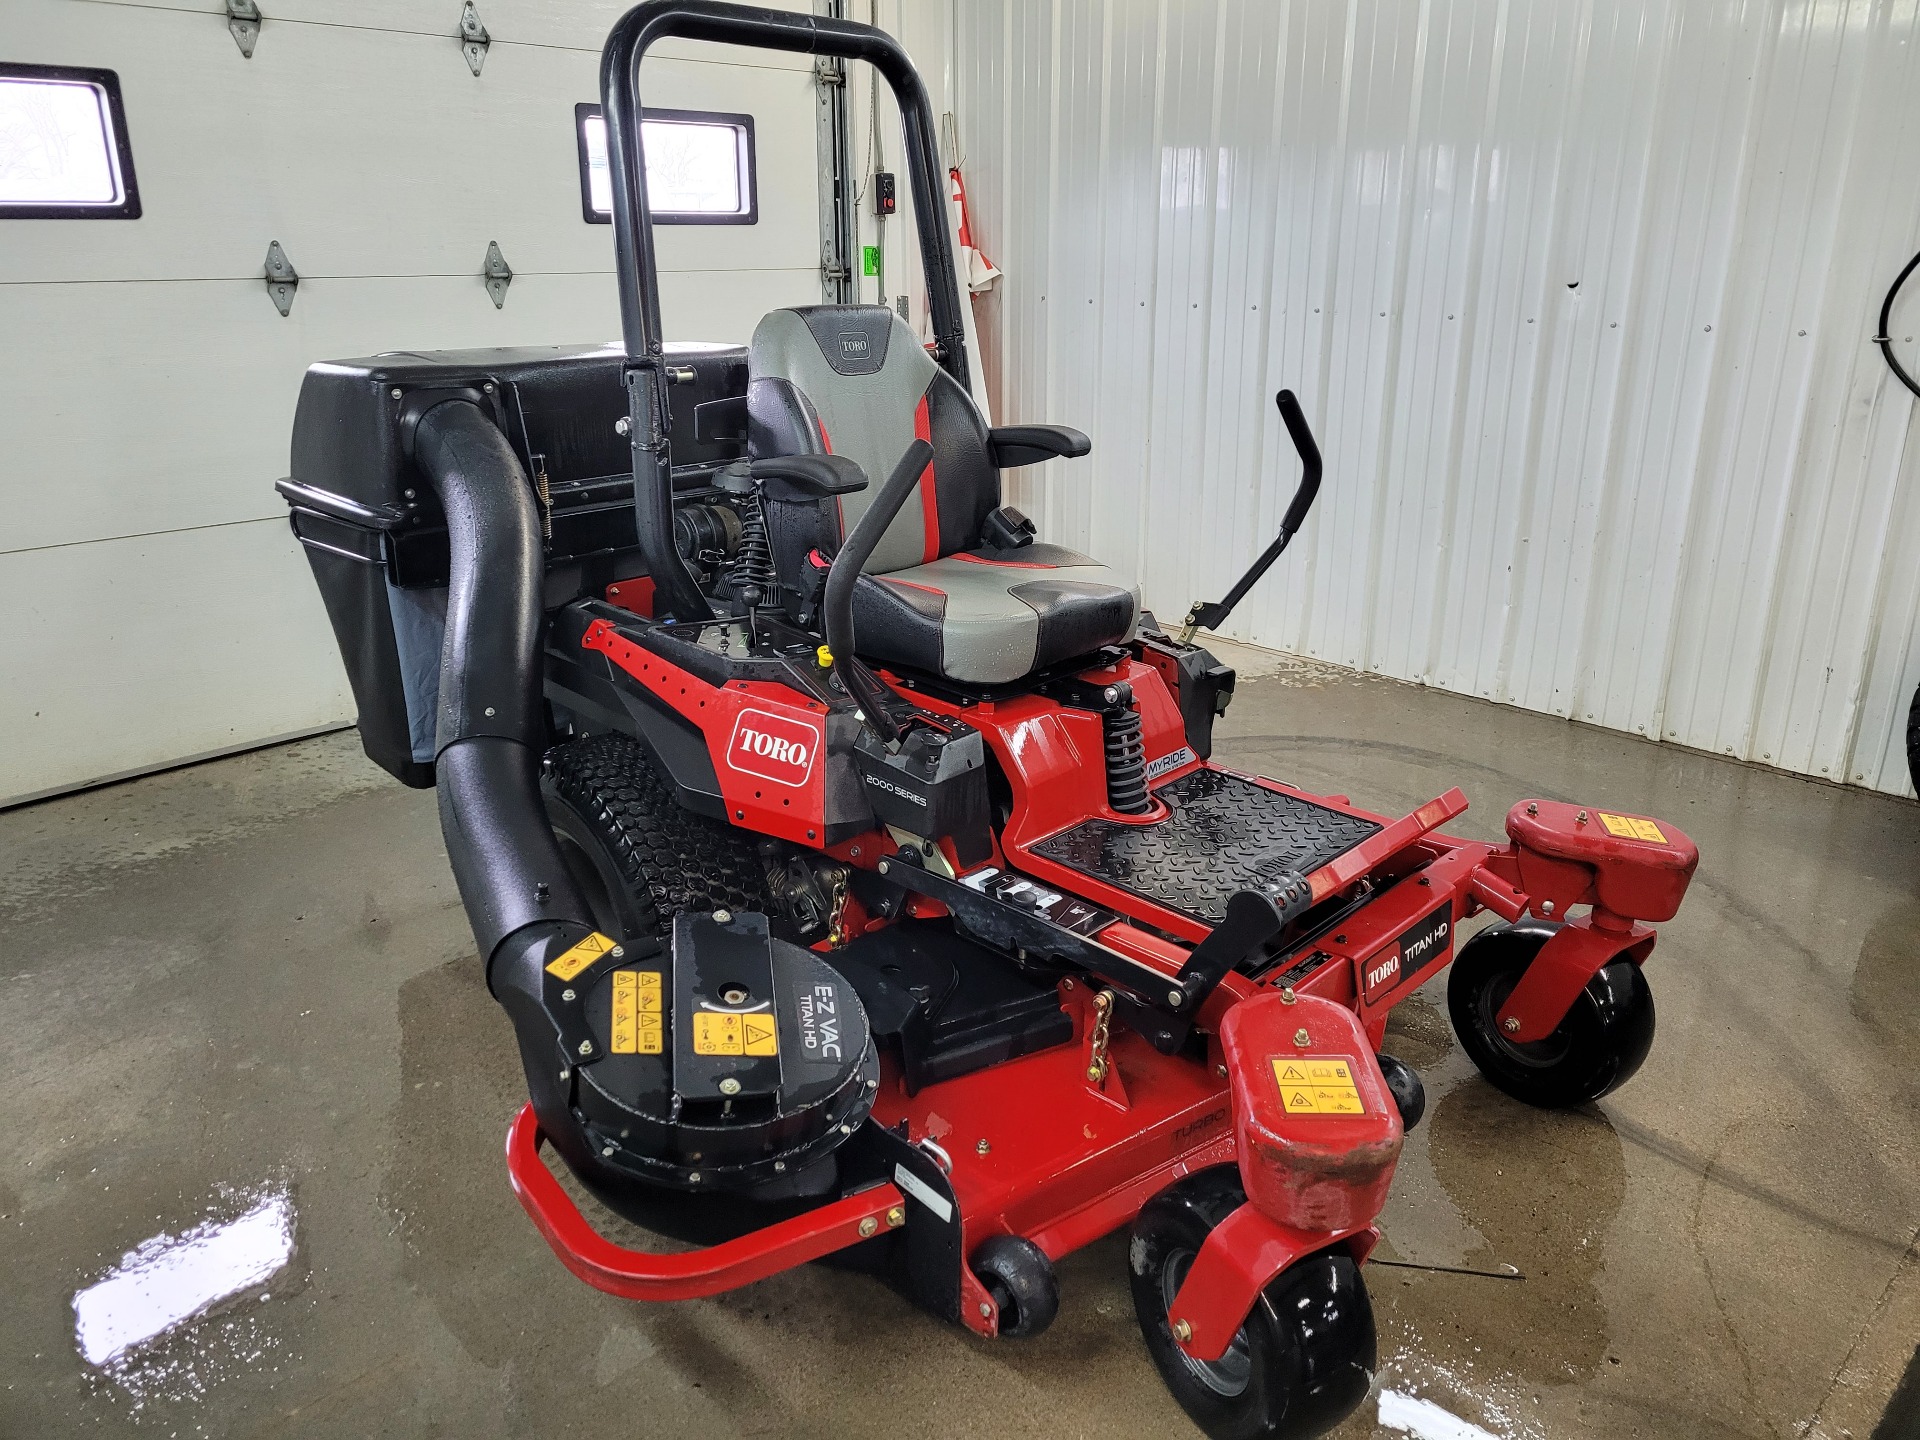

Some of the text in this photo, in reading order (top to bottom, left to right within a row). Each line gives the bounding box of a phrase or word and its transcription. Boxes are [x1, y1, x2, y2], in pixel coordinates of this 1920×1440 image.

[842, 340, 867, 352] TORO
[739, 727, 808, 768] TORO
[866, 774, 927, 808] 2000 SERIES
[1368, 922, 1448, 989] TORO TITAN HD
[800, 994, 818, 1049] TITAN HD
[814, 985, 842, 1058] E-Z VAC
[1172, 1108, 1226, 1140] TURBO
